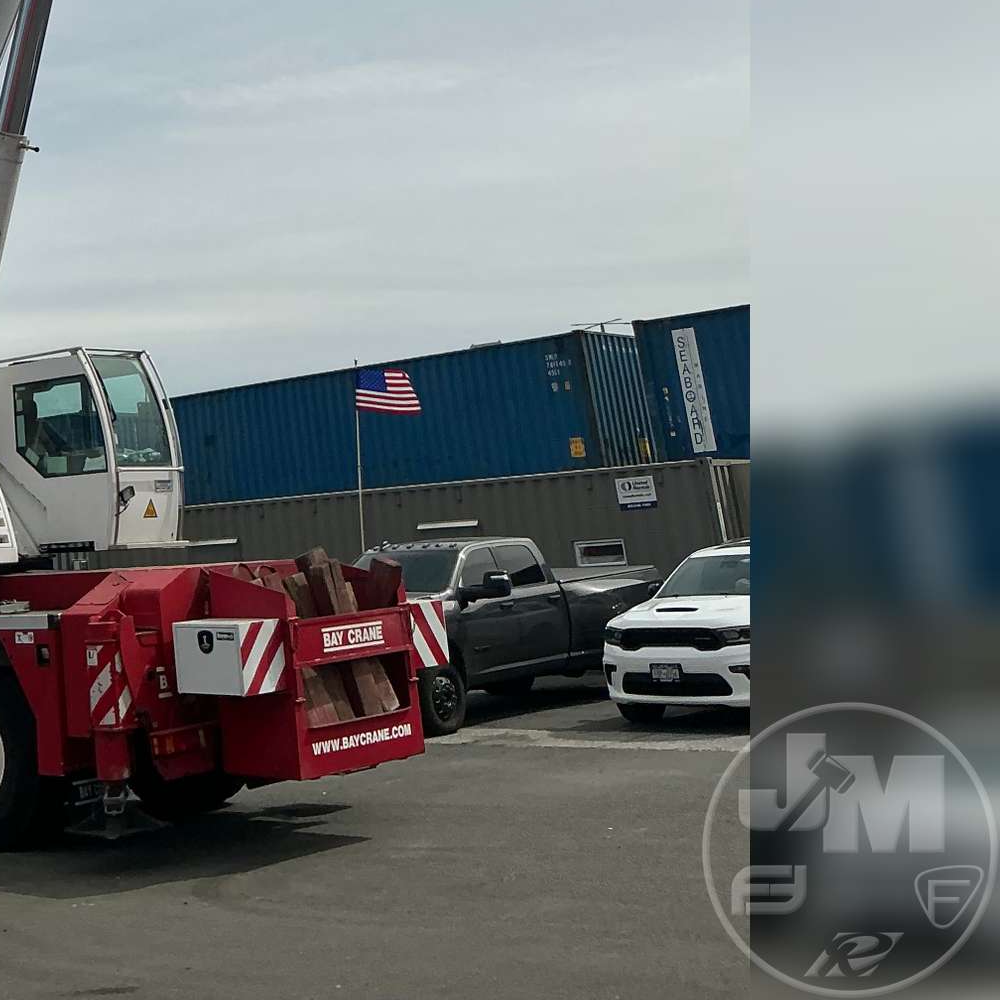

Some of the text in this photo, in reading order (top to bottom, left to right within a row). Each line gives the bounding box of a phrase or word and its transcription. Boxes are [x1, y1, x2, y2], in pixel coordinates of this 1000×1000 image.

[323, 625, 383, 647] BAY CRANE
[312, 723, 412, 756] WWW.BAYCRANE.COM
